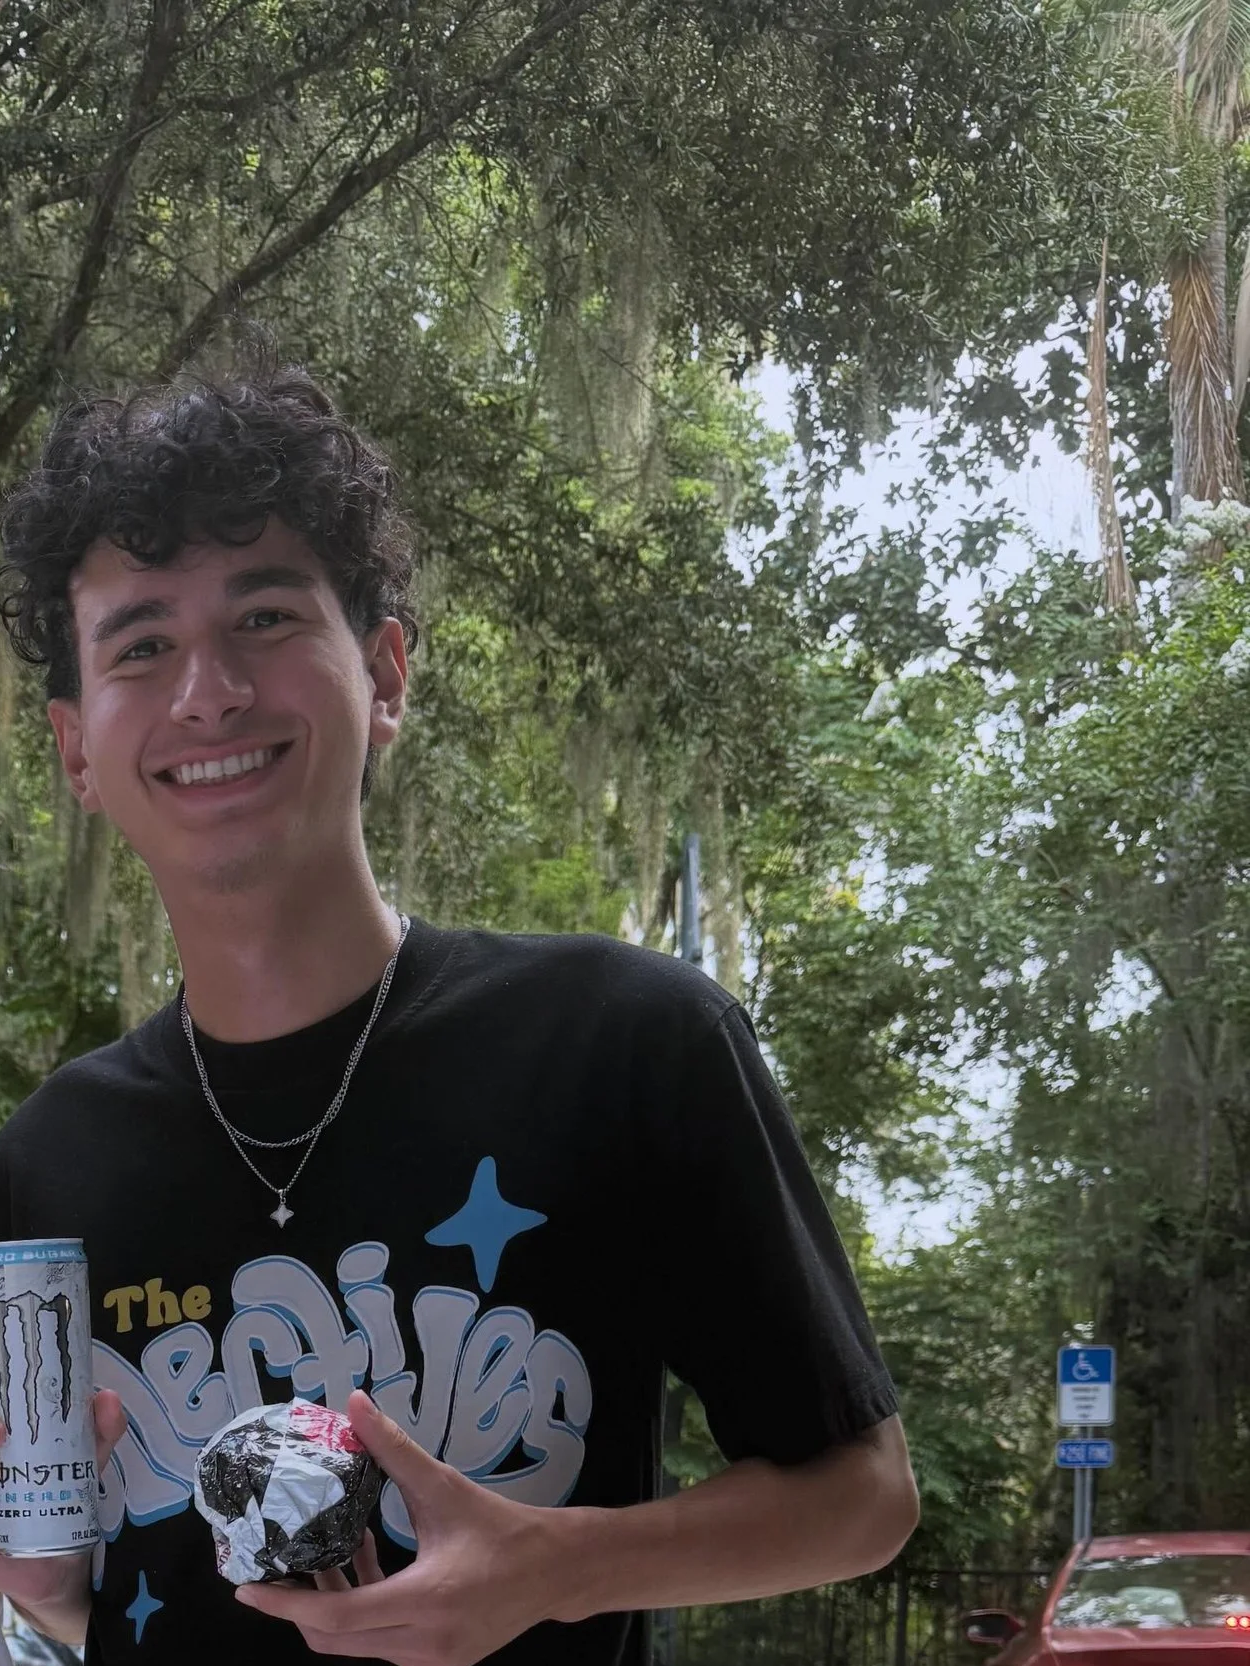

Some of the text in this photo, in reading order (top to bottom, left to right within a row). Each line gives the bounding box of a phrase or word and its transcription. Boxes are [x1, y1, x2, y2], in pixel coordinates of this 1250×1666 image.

[104, 1277, 212, 1333] The
[0, 1505, 83, 1518] ZERO ULTRA
